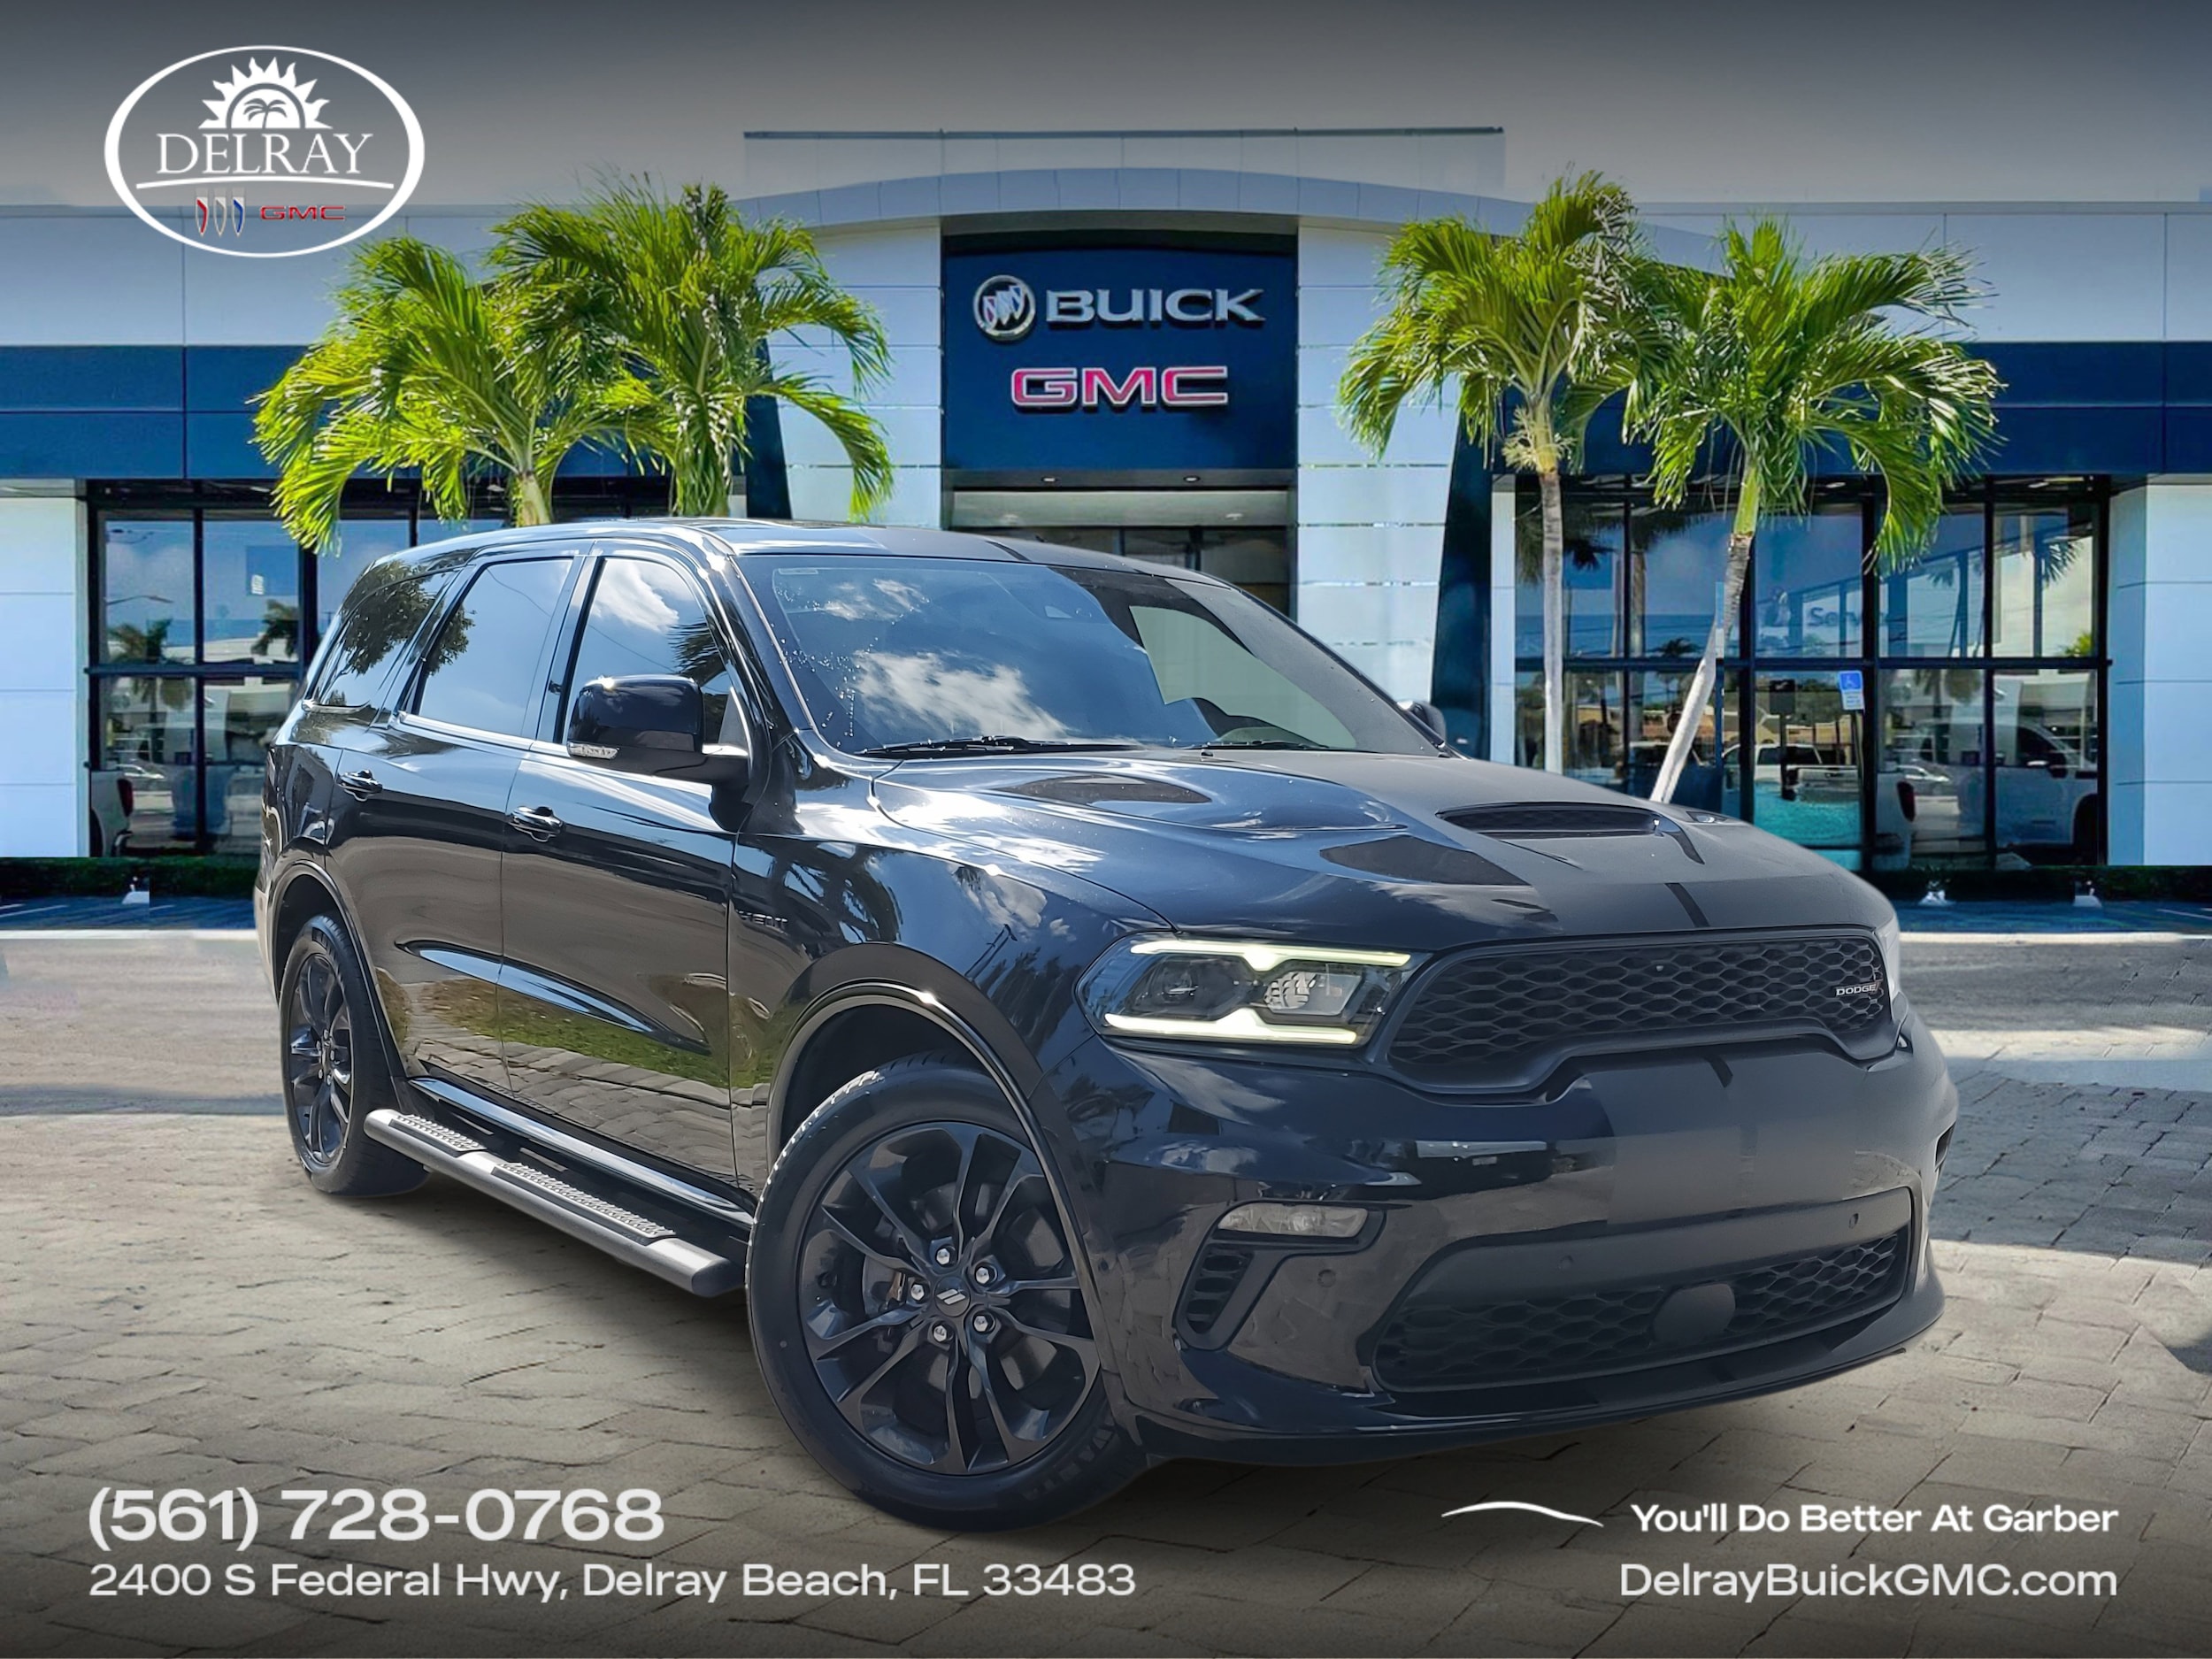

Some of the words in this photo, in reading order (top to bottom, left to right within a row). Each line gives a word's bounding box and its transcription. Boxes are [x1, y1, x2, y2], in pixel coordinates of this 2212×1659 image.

[1046, 288, 1266, 322] BUICK
[1011, 365, 1228, 407] GMC
[1836, 983, 1877, 996] DODGE
